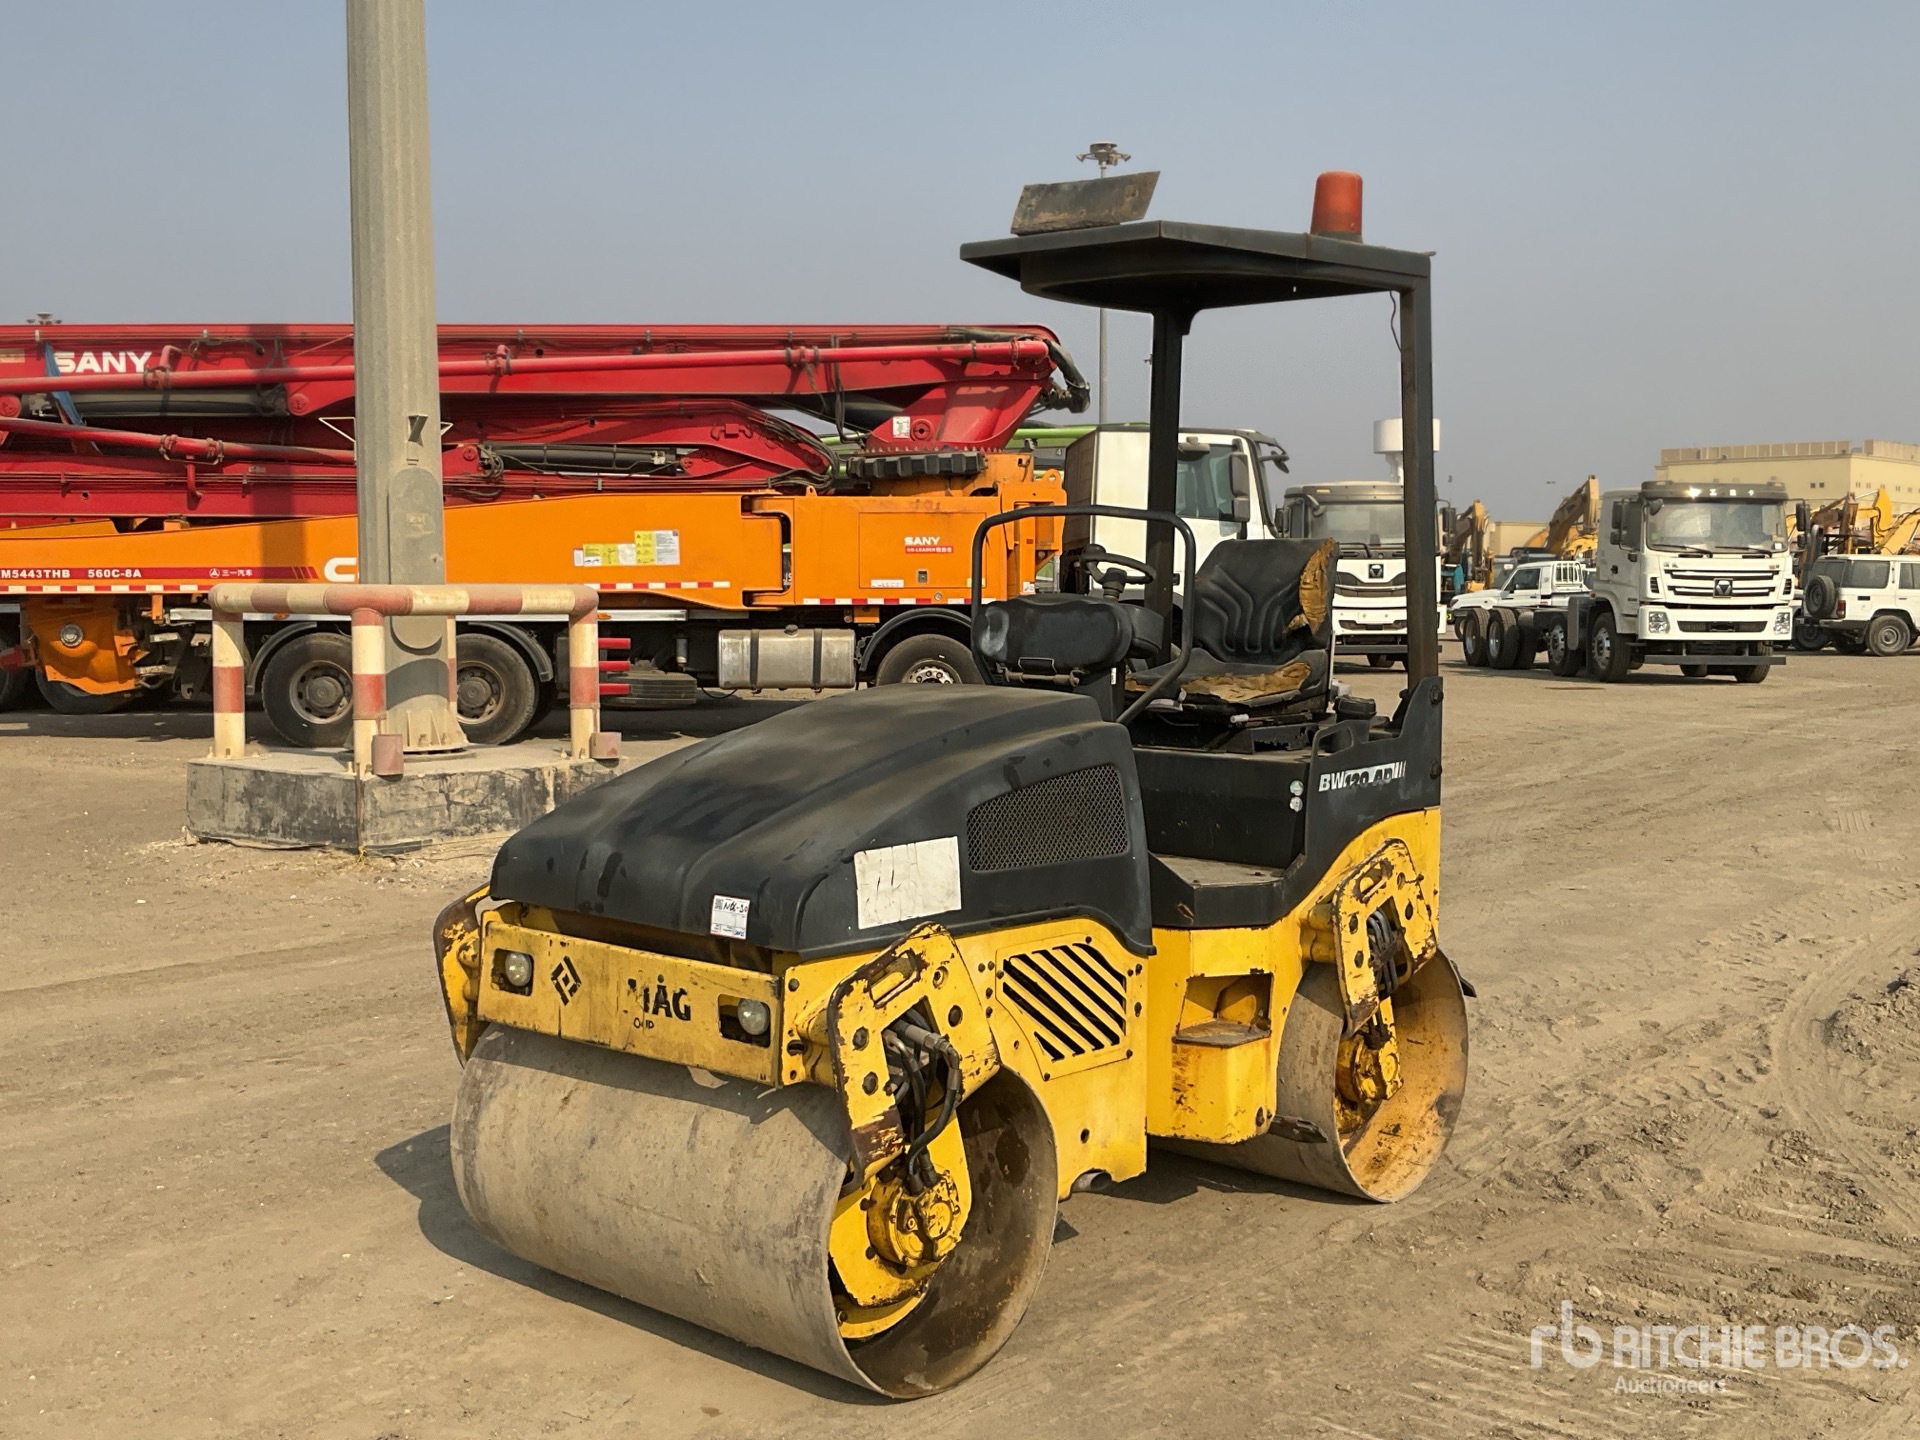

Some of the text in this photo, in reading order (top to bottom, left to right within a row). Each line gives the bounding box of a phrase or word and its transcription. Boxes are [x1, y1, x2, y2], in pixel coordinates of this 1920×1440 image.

[54, 351, 152, 373] SANY
[904, 536, 941, 546] SANY
[88, 568, 142, 578] 560C-8A
